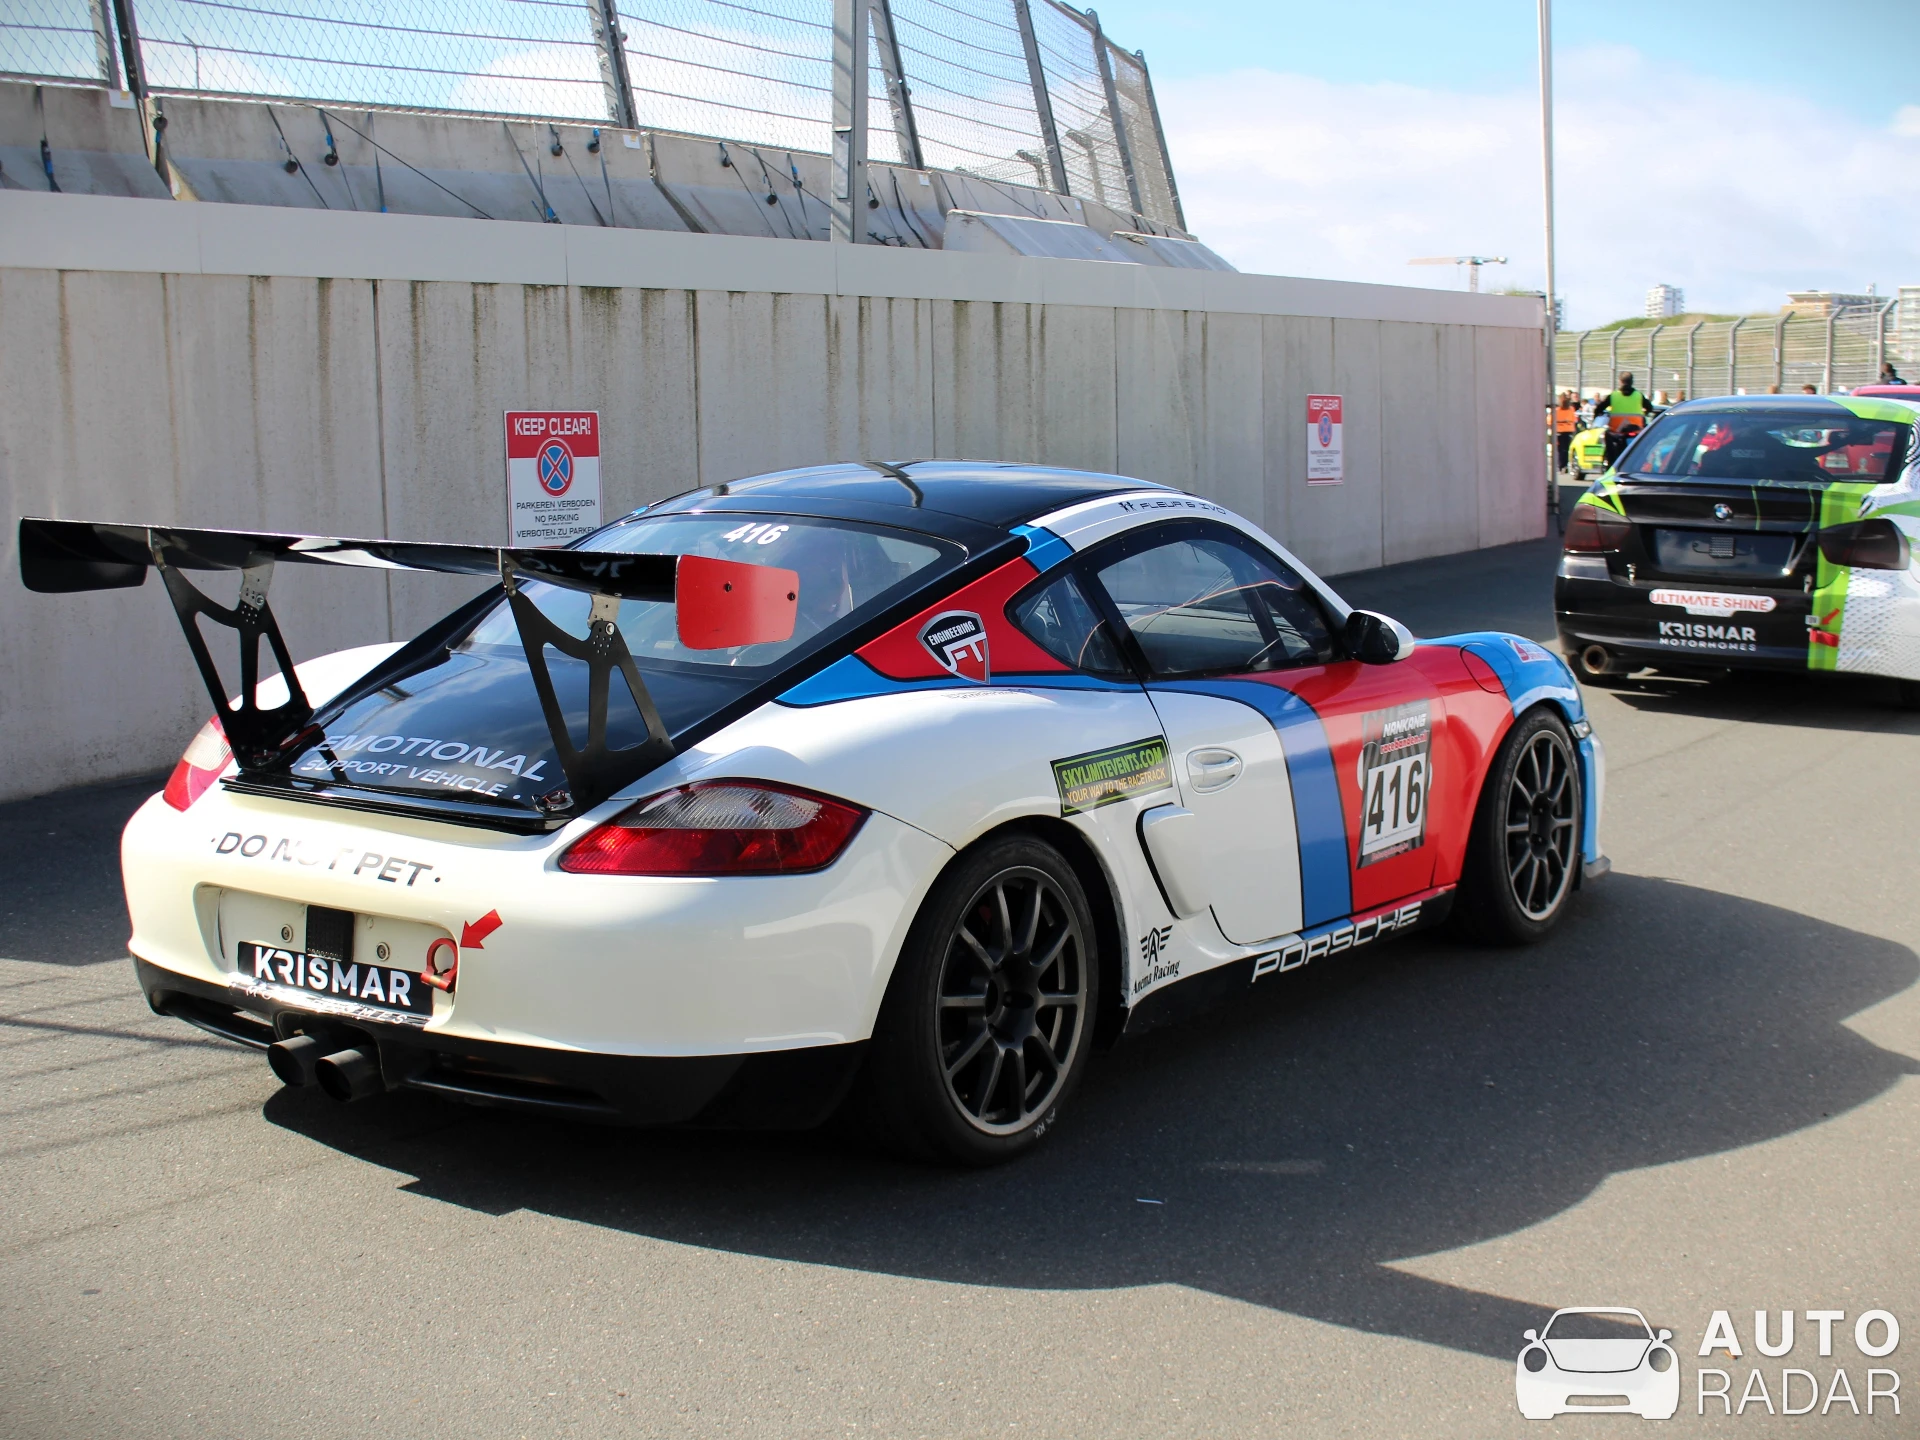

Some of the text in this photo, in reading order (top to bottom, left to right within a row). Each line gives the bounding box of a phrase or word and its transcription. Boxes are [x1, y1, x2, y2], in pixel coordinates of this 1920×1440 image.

[514, 417, 591, 436] KEEP CLEAR!
[516, 499, 596, 510] PARKEREN VERBODEN
[535, 513, 579, 523] NO PARKING
[516, 528, 556, 538] VERBOTEN
[557, 528, 567, 536] ZU
[723, 522, 789, 545] 416
[1650, 593, 1768, 611] ULTIMATE SHINE
[928, 620, 976, 646] ENGINEERING
[1658, 621, 1756, 642] KRISMAR
[1659, 637, 1757, 652] MOTORHOMES
[1382, 713, 1427, 738] NANKANG
[312, 735, 547, 782] EMOTIONAL
[1062, 746, 1163, 789] SKYLIMITEVENTS.COM
[300, 759, 509, 797] SUPPORT VEHICLE
[1067, 767, 1166, 804] YOUR WAY TO THE RACETRACK
[1367, 760, 1423, 836] 416
[215, 832, 268, 858] DO
[353, 852, 433, 887] PET
[1251, 901, 1422, 983] PORSCHE
[253, 946, 411, 1007] KRISMAR
[1153, 961, 1180, 981] Racing
